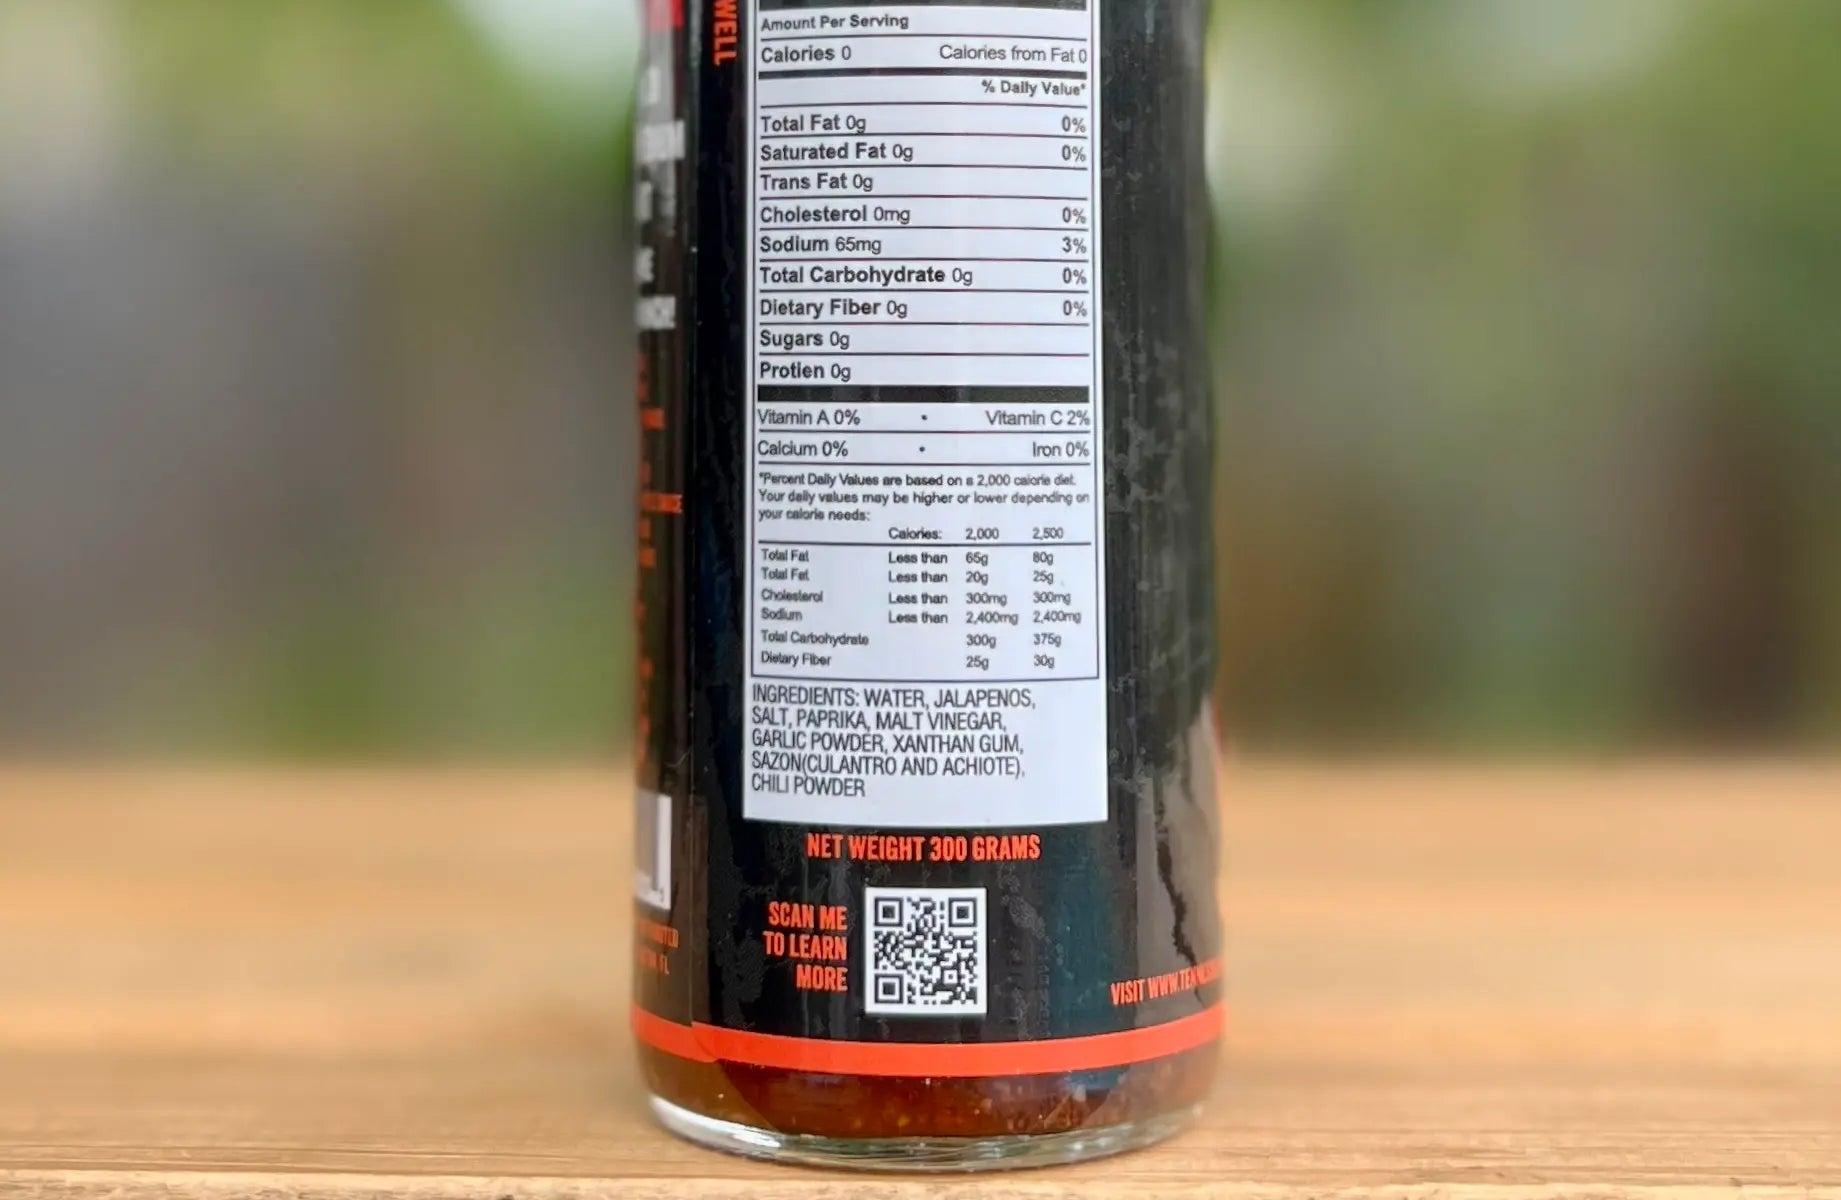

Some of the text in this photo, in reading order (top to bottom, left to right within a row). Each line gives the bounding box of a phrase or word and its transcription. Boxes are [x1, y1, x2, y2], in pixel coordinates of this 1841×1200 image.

[761, 14, 909, 31] Amount Per Serving
[761, 45, 851, 63] Calories 0
[940, 44, 1087, 64] Calories from Fat 0
[981, 80, 995, 93] %
[1001, 80, 1037, 97] Daily
[761, 114, 867, 134] Total Fat 0g
[1062, 115, 1086, 133] 0%
[761, 142, 913, 162] Saturated Fat 0g
[1062, 145, 1086, 162] 0%
[760, 172, 873, 192] Trans Fat 0g
[760, 205, 910, 225] Cholesterol 0mg
[1062, 207, 1086, 224] 0%
[760, 236, 881, 255] Sodium 65mg
[1062, 236, 1086, 254] 3%
[760, 266, 972, 287] Total Carbohydrate 0g
[1062, 267, 1087, 284] 0%
[760, 298, 907, 319] Dietary Fiber 0g
[1063, 300, 1087, 317] 0%
[760, 329, 849, 350] Sugars 0g
[760, 361, 851, 382] Protien 0g
[757, 409, 860, 425] Vitamin A 0%
[985, 410, 1090, 425] Vitamin C 2%
[758, 440, 848, 457] Calcium 0%
[1033, 441, 1089, 457] Iron 0%
[808, 473, 836, 488] Daily
[839, 473, 879, 486] Values
[883, 477, 902, 486] are
[906, 474, 943, 486] based
[947, 477, 962, 486] on
[977, 474, 1010, 487] 2,000
[1014, 474, 1050, 486] calorie
[1054, 474, 1075, 486] diet.
[758, 489, 1089, 506] Your daily values may be higher or lower depending on
[758, 508, 869, 522] your calorie needs:
[889, 527, 1064, 541] Calories: 2,000 2,500
[761, 549, 1053, 566] Total Fat Less than 65g 80g
[761, 567, 1053, 586] Total Fat Less than 20g 25g
[761, 588, 1071, 607] Cholesterol Less than 300mg 300mg
[761, 607, 1081, 625] Sodium Less than 2,400mg 2,400mg
[761, 630, 1061, 649] Total Carbohydrate 300g 375g
[761, 651, 1054, 671] Dietary Fiber 25g 30g
[752, 683, 1035, 710] INGREDIENTS: WATER, JALAPENOS,
[752, 705, 1006, 732] SALT, PAPRIKA, MALT VINEGAR,
[752, 728, 1023, 755] GARLIC POWDER, XANTHAN GUM,
[752, 752, 1024, 779] SAZON(CULANTRO AND ACHIOTE),
[752, 773, 865, 797] CHILI POWDER
[807, 832, 1040, 861] NET WEIGHT 300 GRAMS
[769, 903, 847, 931] SCAN ME
[763, 932, 847, 960] TO LEARN
[796, 966, 847, 992] MORE
[1111, 979, 1145, 1005] VISIT
